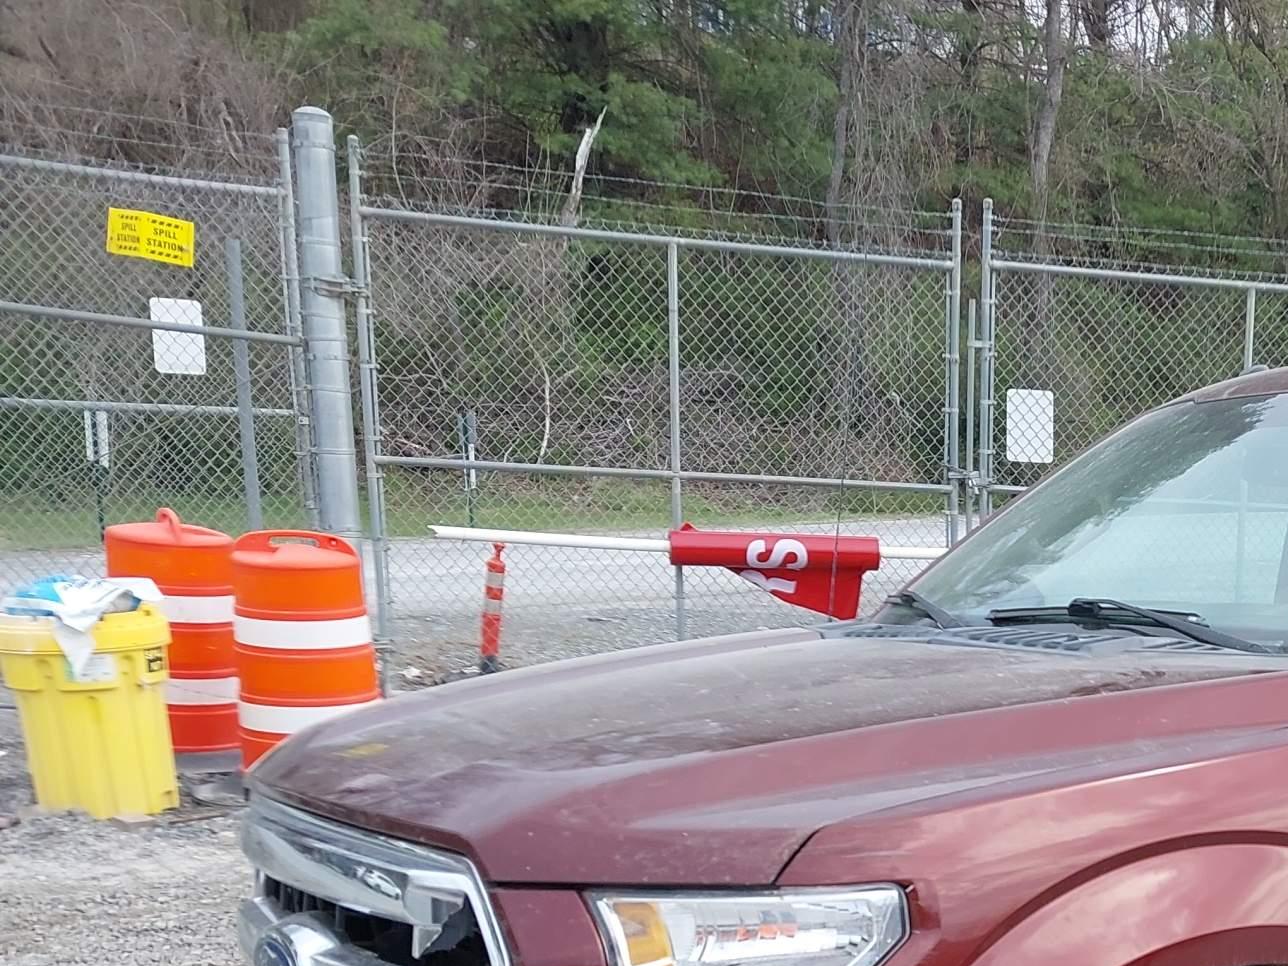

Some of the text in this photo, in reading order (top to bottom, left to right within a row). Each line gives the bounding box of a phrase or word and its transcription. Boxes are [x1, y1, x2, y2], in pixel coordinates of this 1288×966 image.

[121, 223, 137, 232] SPILL
[152, 228, 178, 240] SPILL
[146, 238, 184, 252] STATION
